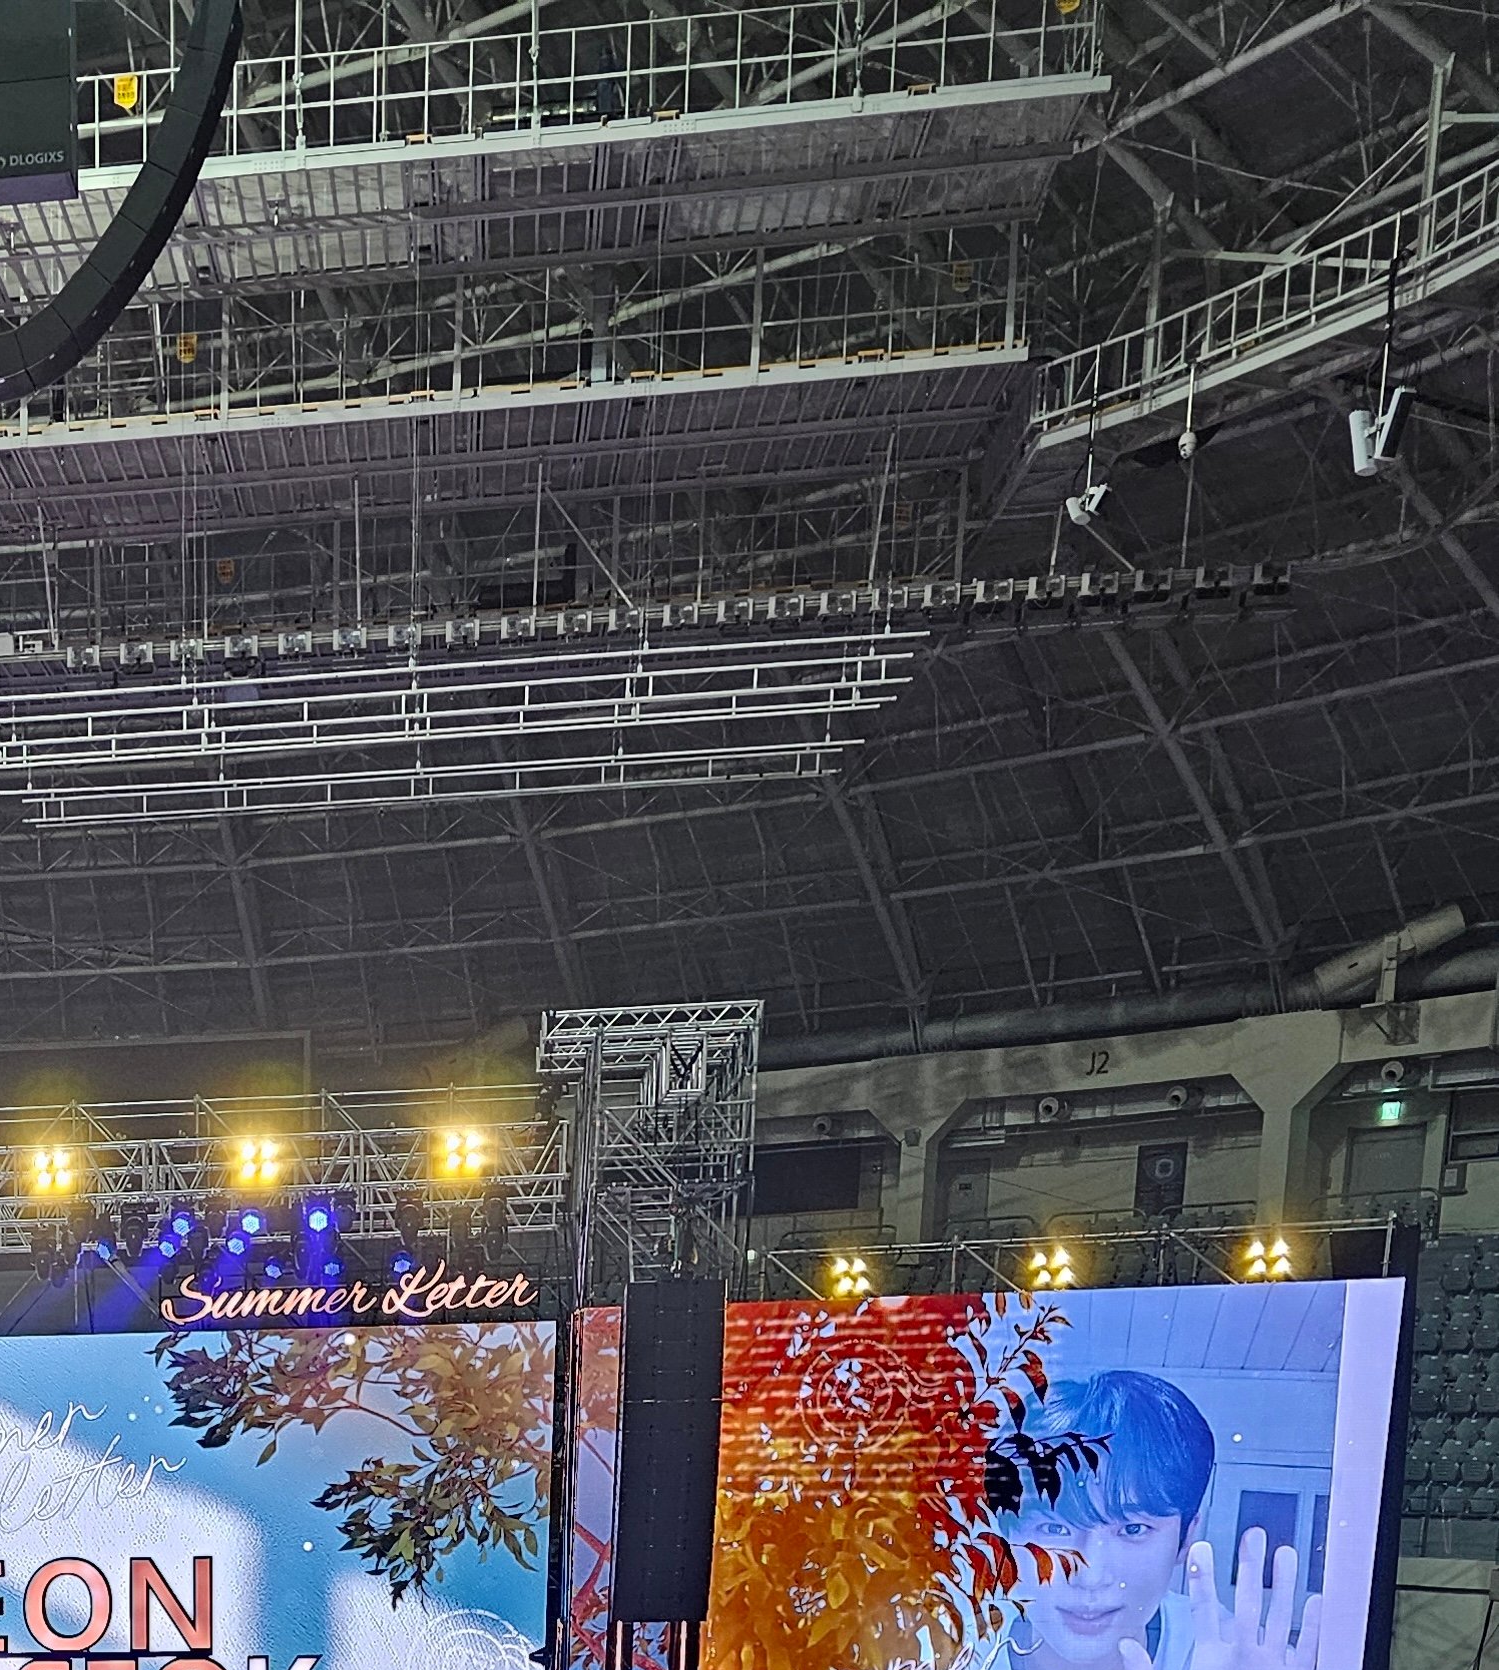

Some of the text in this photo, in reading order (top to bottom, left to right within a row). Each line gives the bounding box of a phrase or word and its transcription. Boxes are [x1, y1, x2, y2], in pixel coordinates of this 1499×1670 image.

[9, 151, 65, 166] DLOGIXS
[1086, 1050, 1110, 1076] J2
[161, 1259, 538, 1325] Summer Letter
